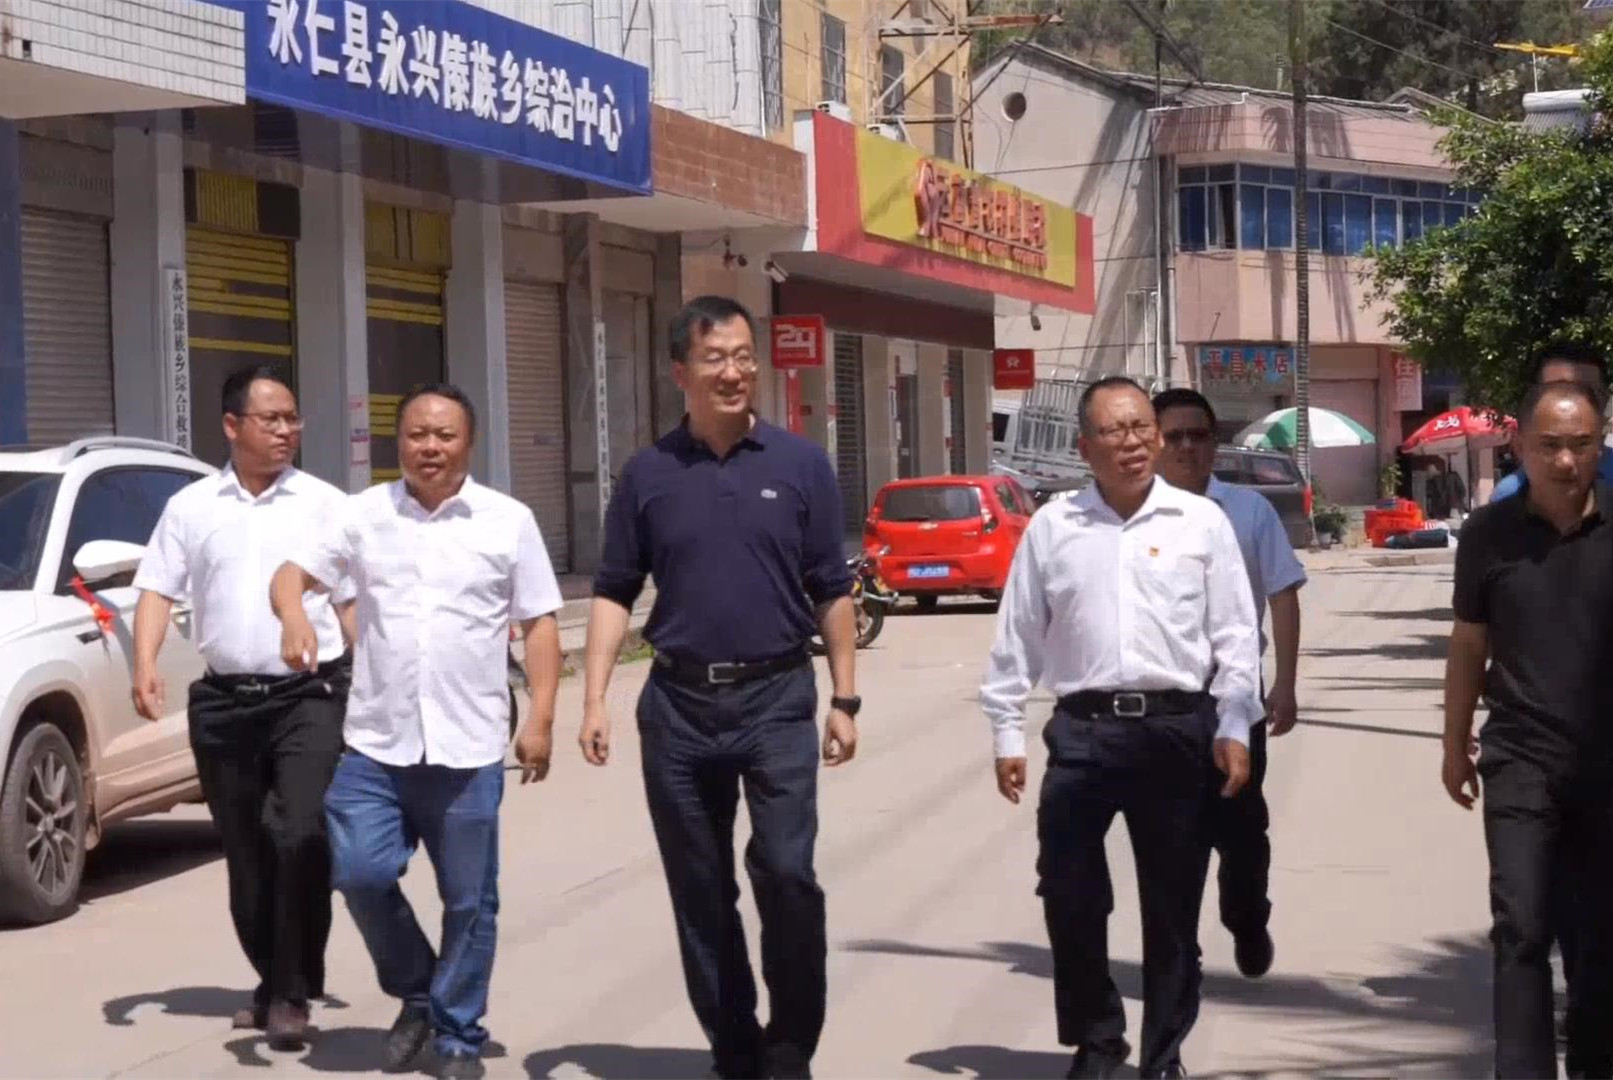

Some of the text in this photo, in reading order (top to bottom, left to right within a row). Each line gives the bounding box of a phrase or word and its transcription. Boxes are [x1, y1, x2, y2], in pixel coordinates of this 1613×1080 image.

[267, 0, 622, 152] 永仁县永兴傣族乡综治中心
